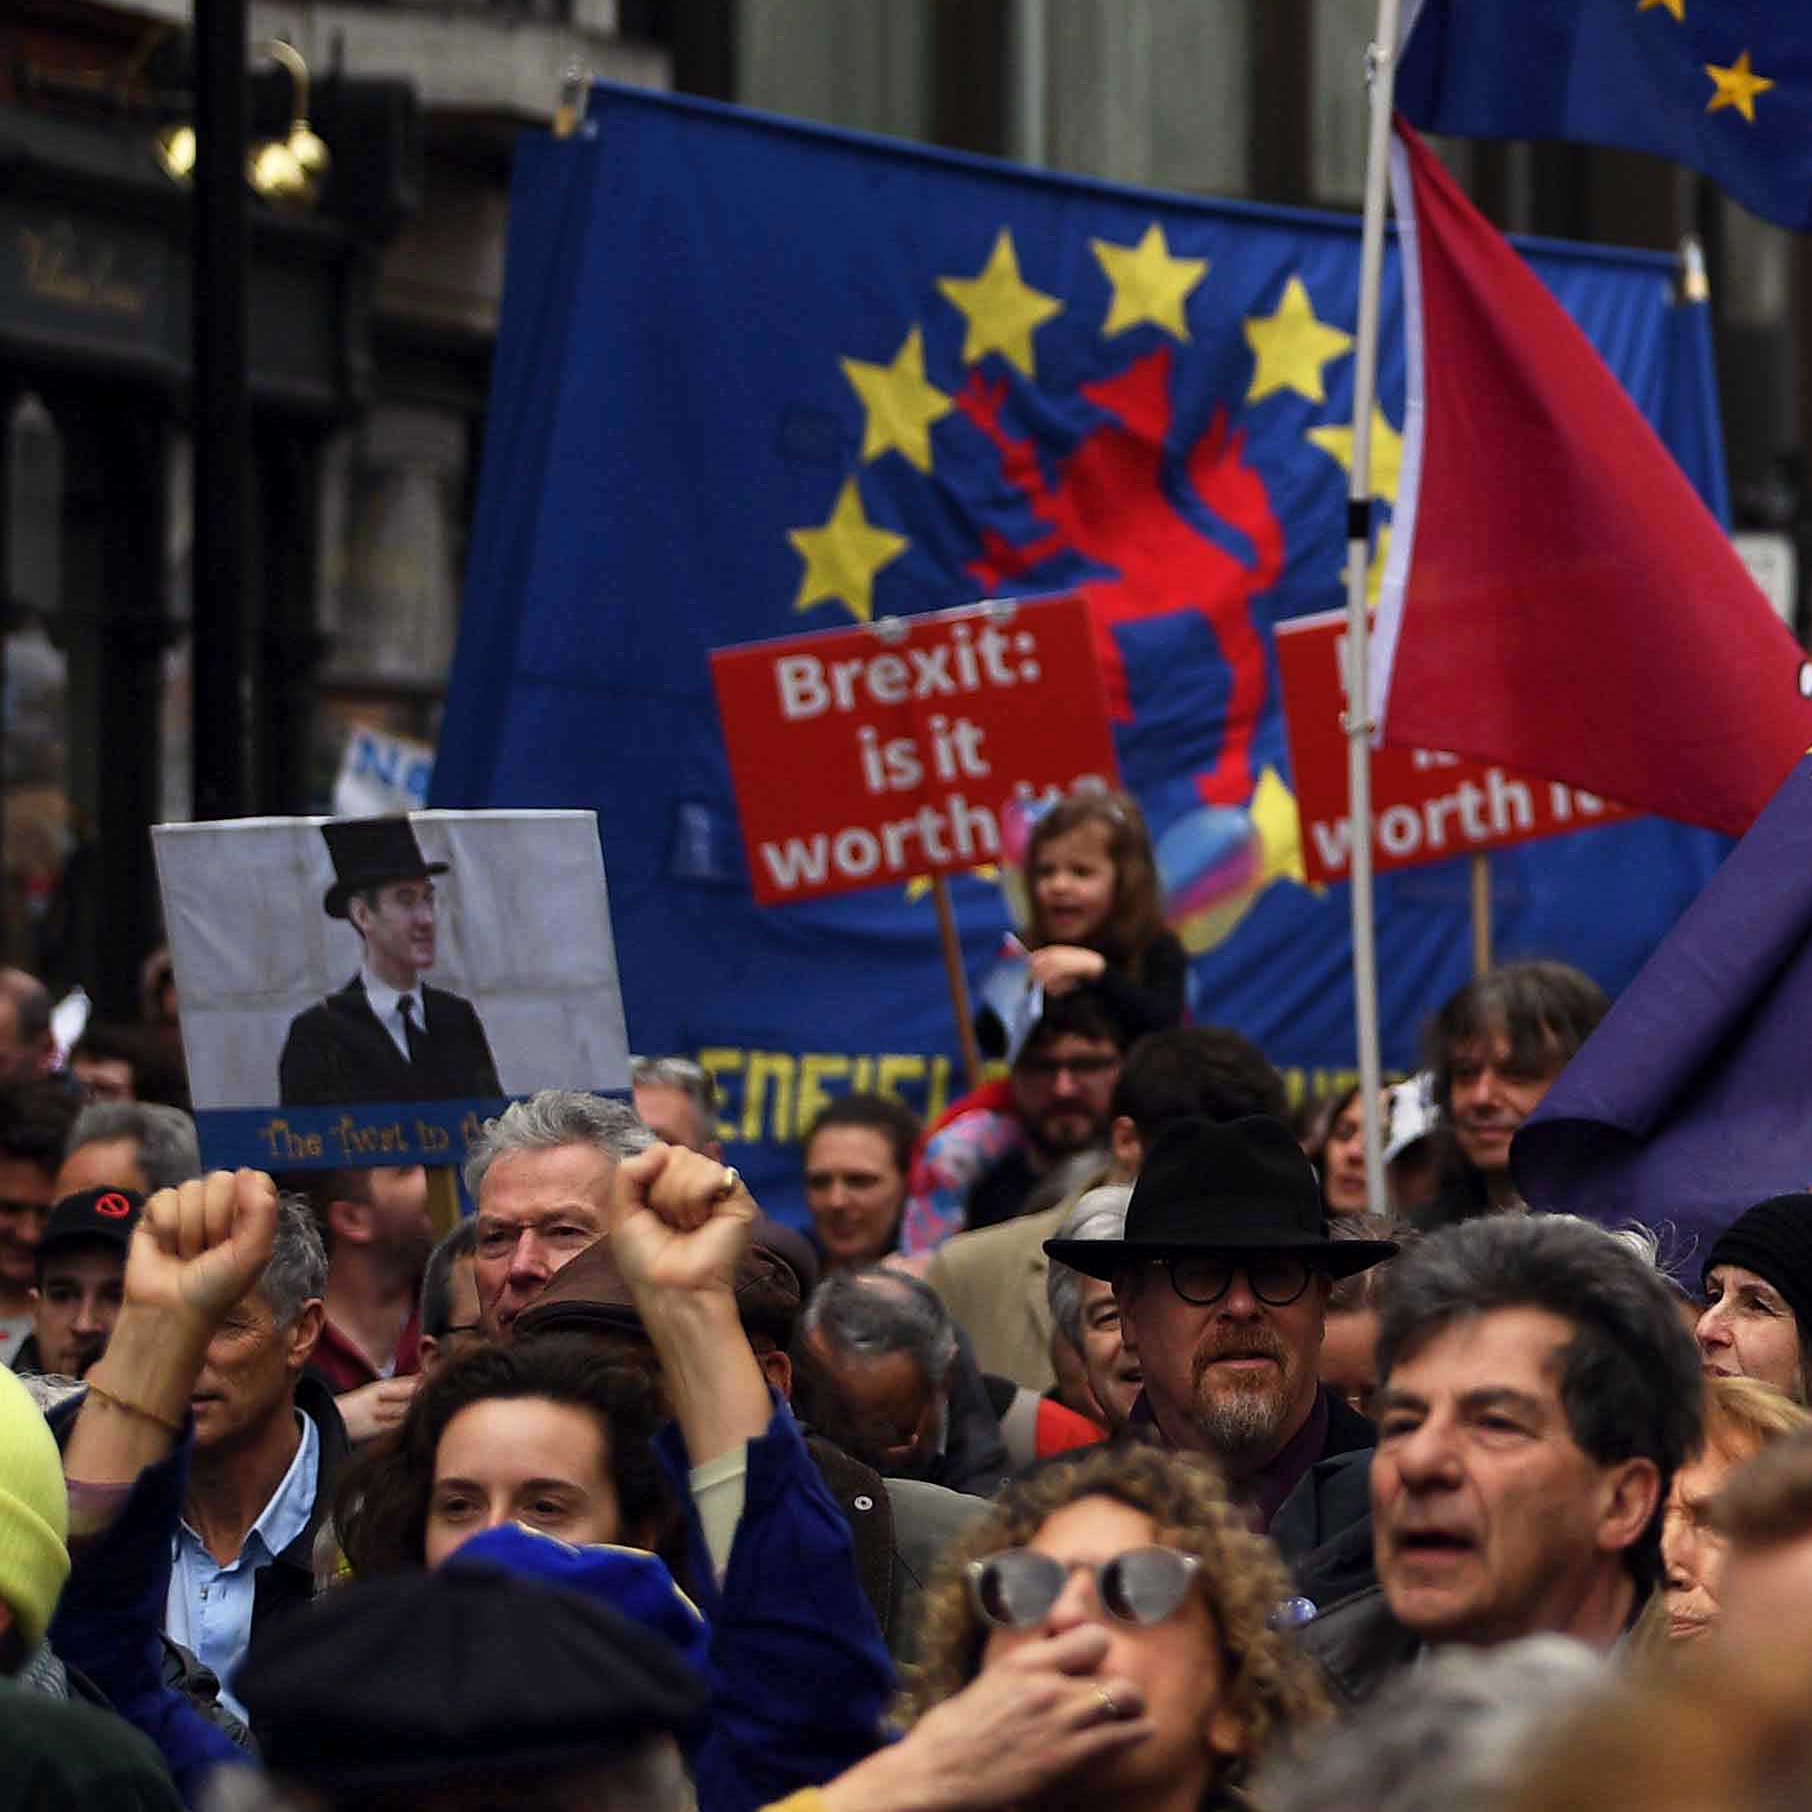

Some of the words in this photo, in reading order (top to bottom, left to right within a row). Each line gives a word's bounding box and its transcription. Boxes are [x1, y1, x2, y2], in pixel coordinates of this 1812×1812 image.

[773, 622, 1042, 722] Brexit:
[856, 725, 923, 796] is
[928, 714, 992, 783] it
[759, 792, 1000, 891] worth
[1310, 767, 1533, 870] worth
